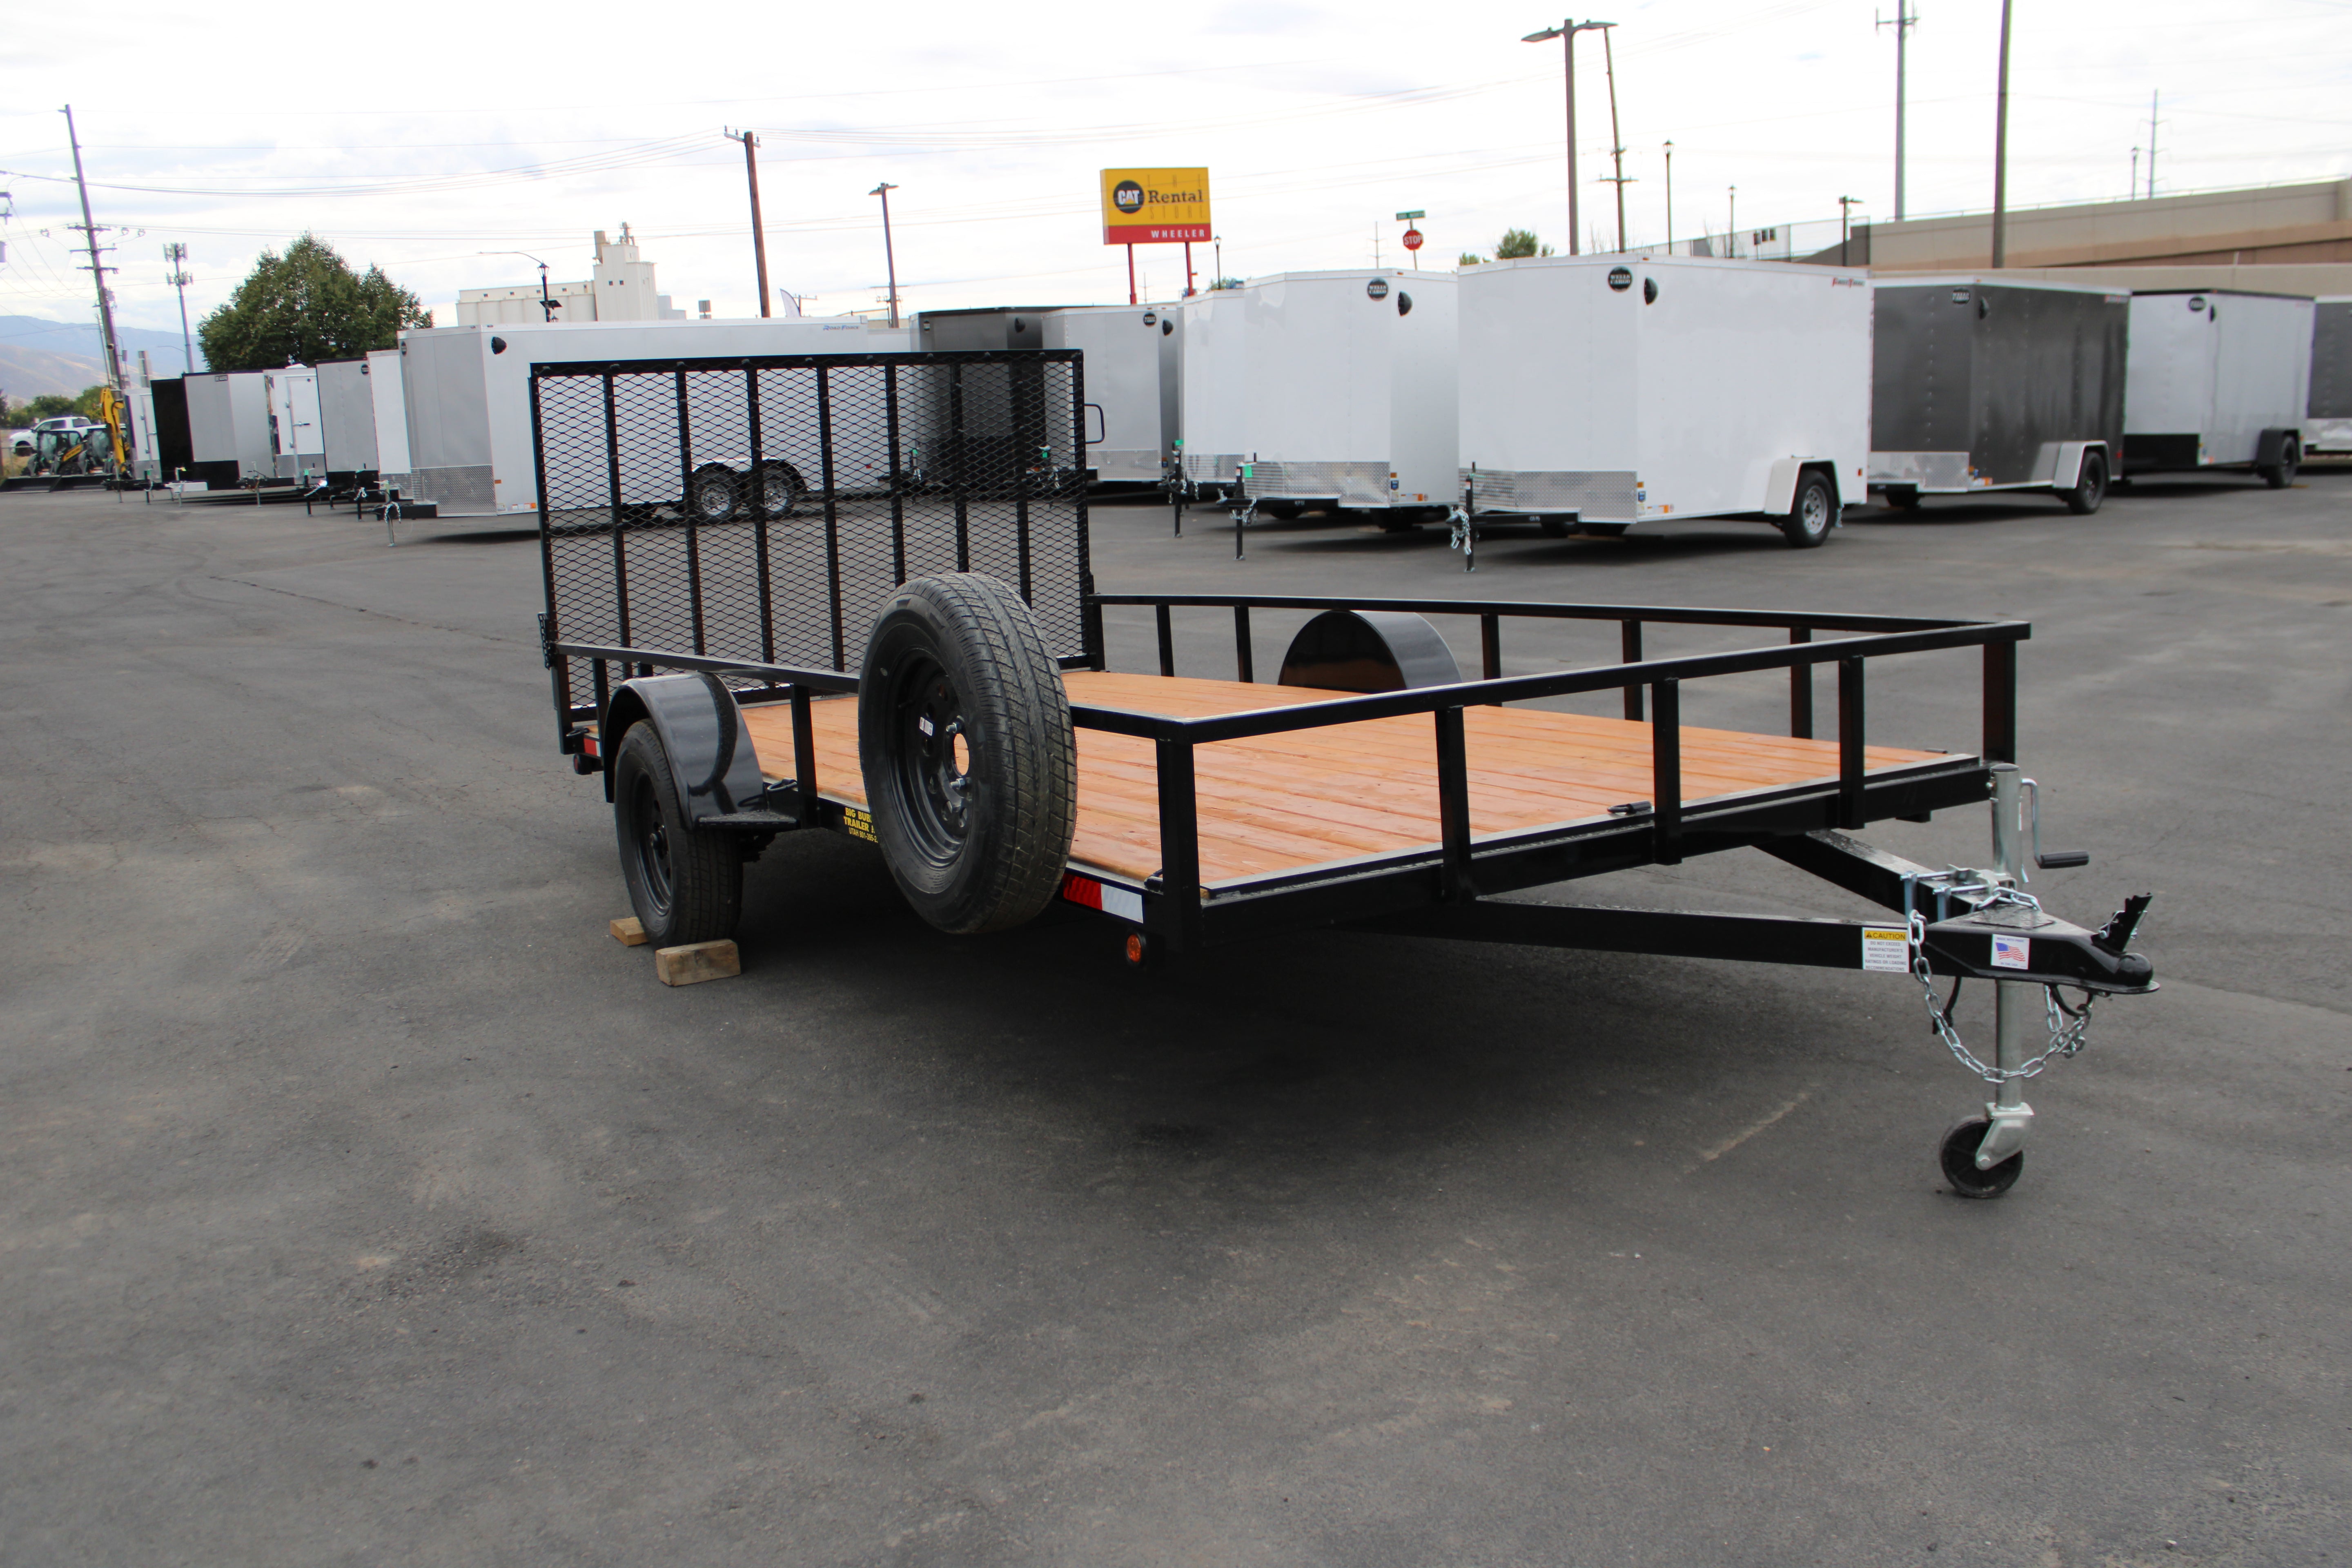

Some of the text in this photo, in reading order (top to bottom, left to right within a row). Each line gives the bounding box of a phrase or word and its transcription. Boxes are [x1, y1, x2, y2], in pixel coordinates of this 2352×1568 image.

[1118, 190, 1140, 205] CAT
[1148, 189, 1203, 203] Rental
[1150, 205, 1204, 219] STORE
[1151, 229, 1205, 238] WHEELER
[1404, 235, 1423, 245] STOP
[845, 807, 872, 823] BIG BUB
[843, 816, 869, 832] TRAILER
[849, 827, 859, 836] UTAH
[859, 831, 878, 843] 801-395-2
